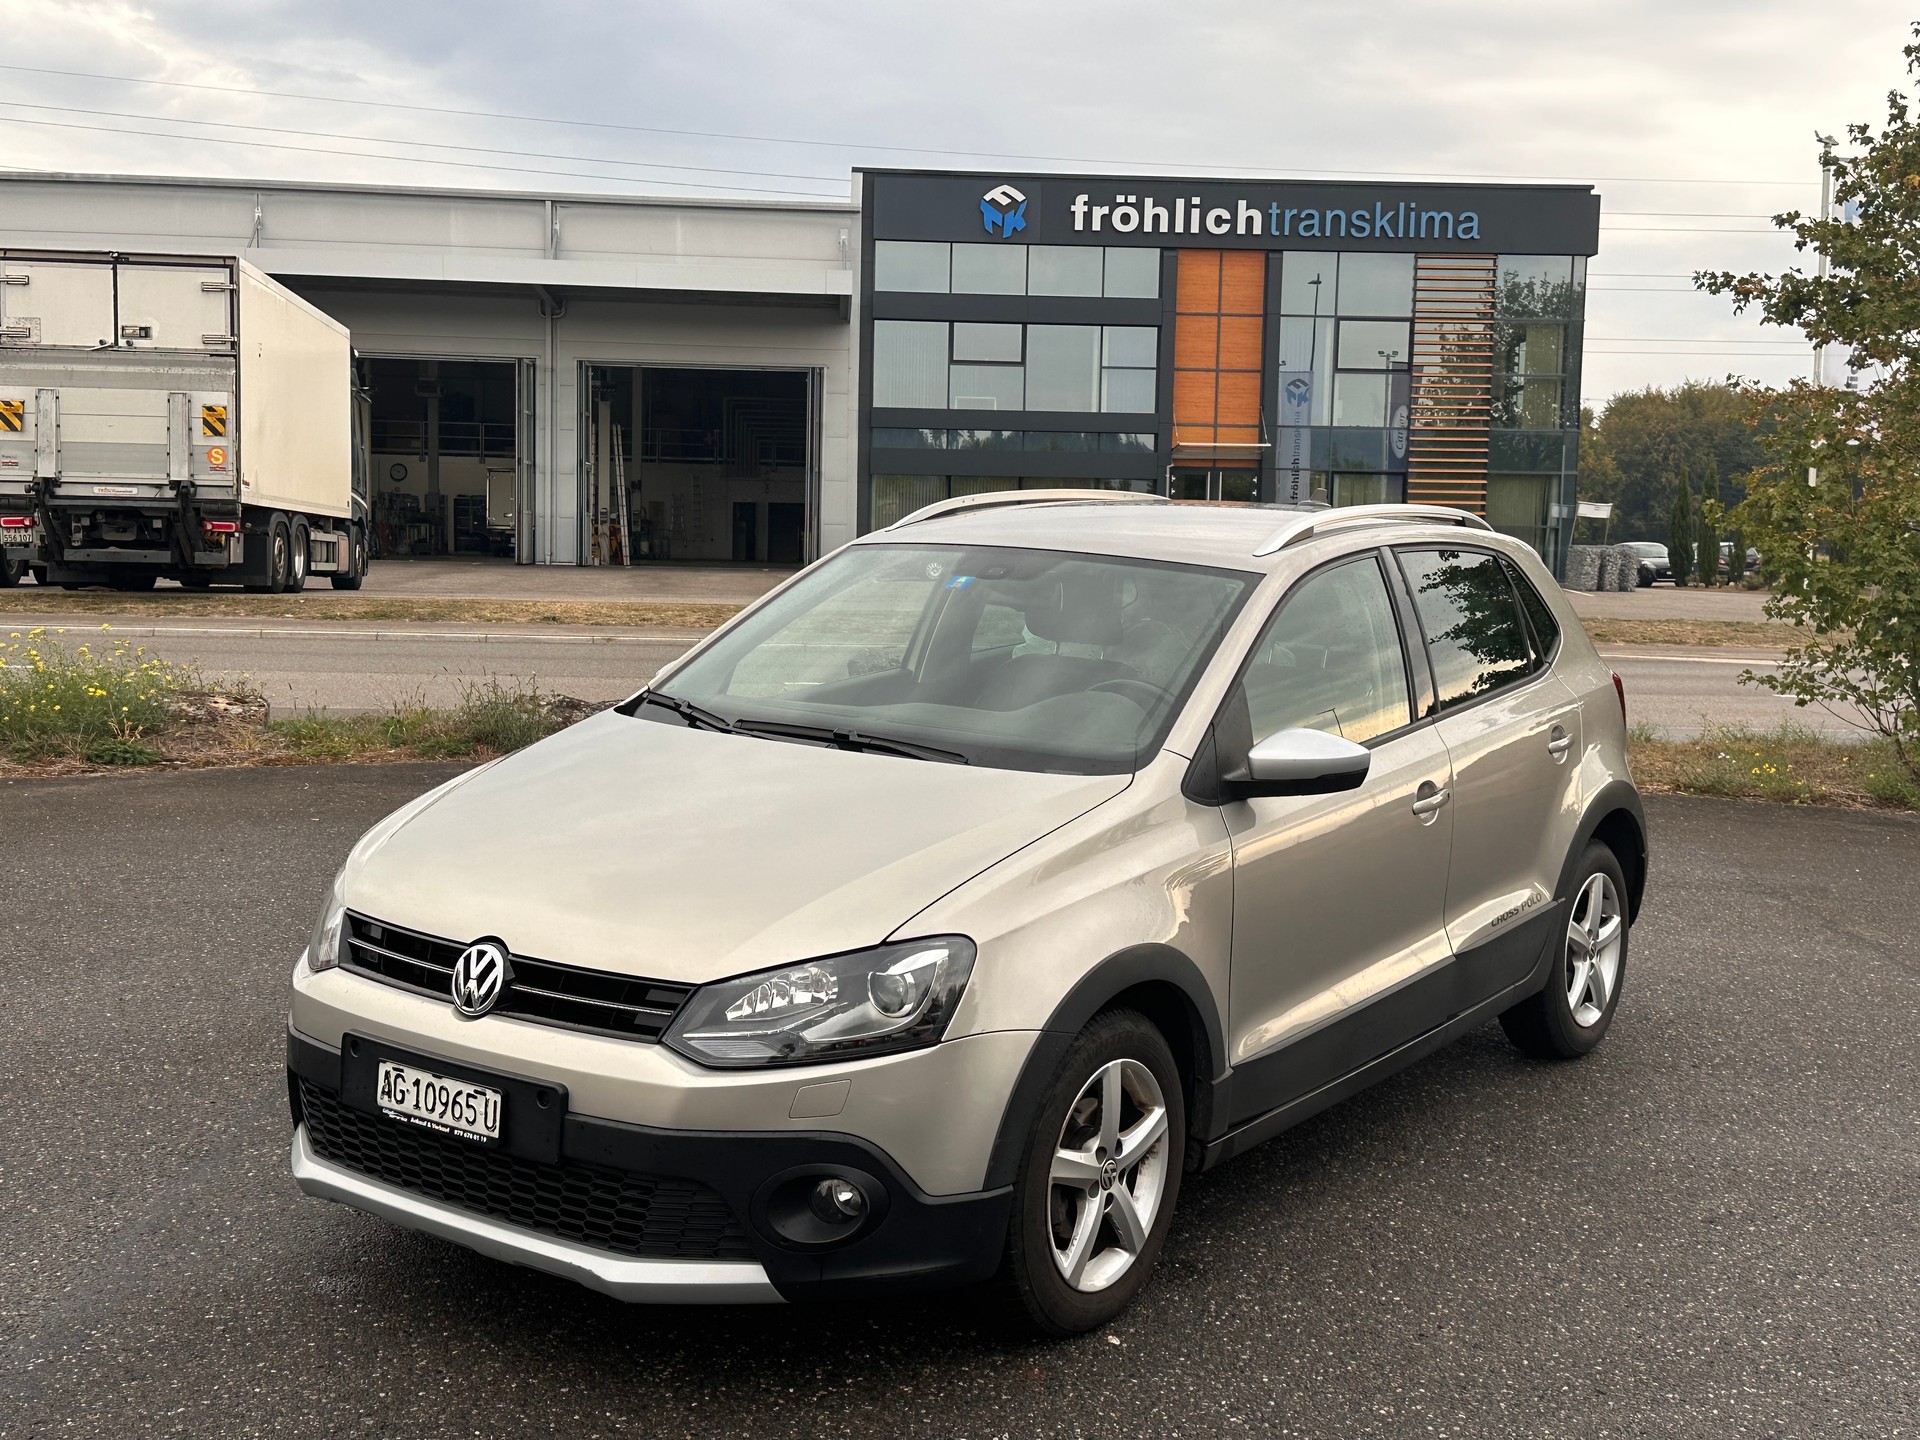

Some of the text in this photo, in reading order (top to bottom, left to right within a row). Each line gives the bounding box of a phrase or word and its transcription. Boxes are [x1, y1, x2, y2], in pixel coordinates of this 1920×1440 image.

[1070, 194, 1480, 239] fröhlich transklima
[210, 448, 223, 465] S
[1491, 893, 1542, 927] CROSS POLO
